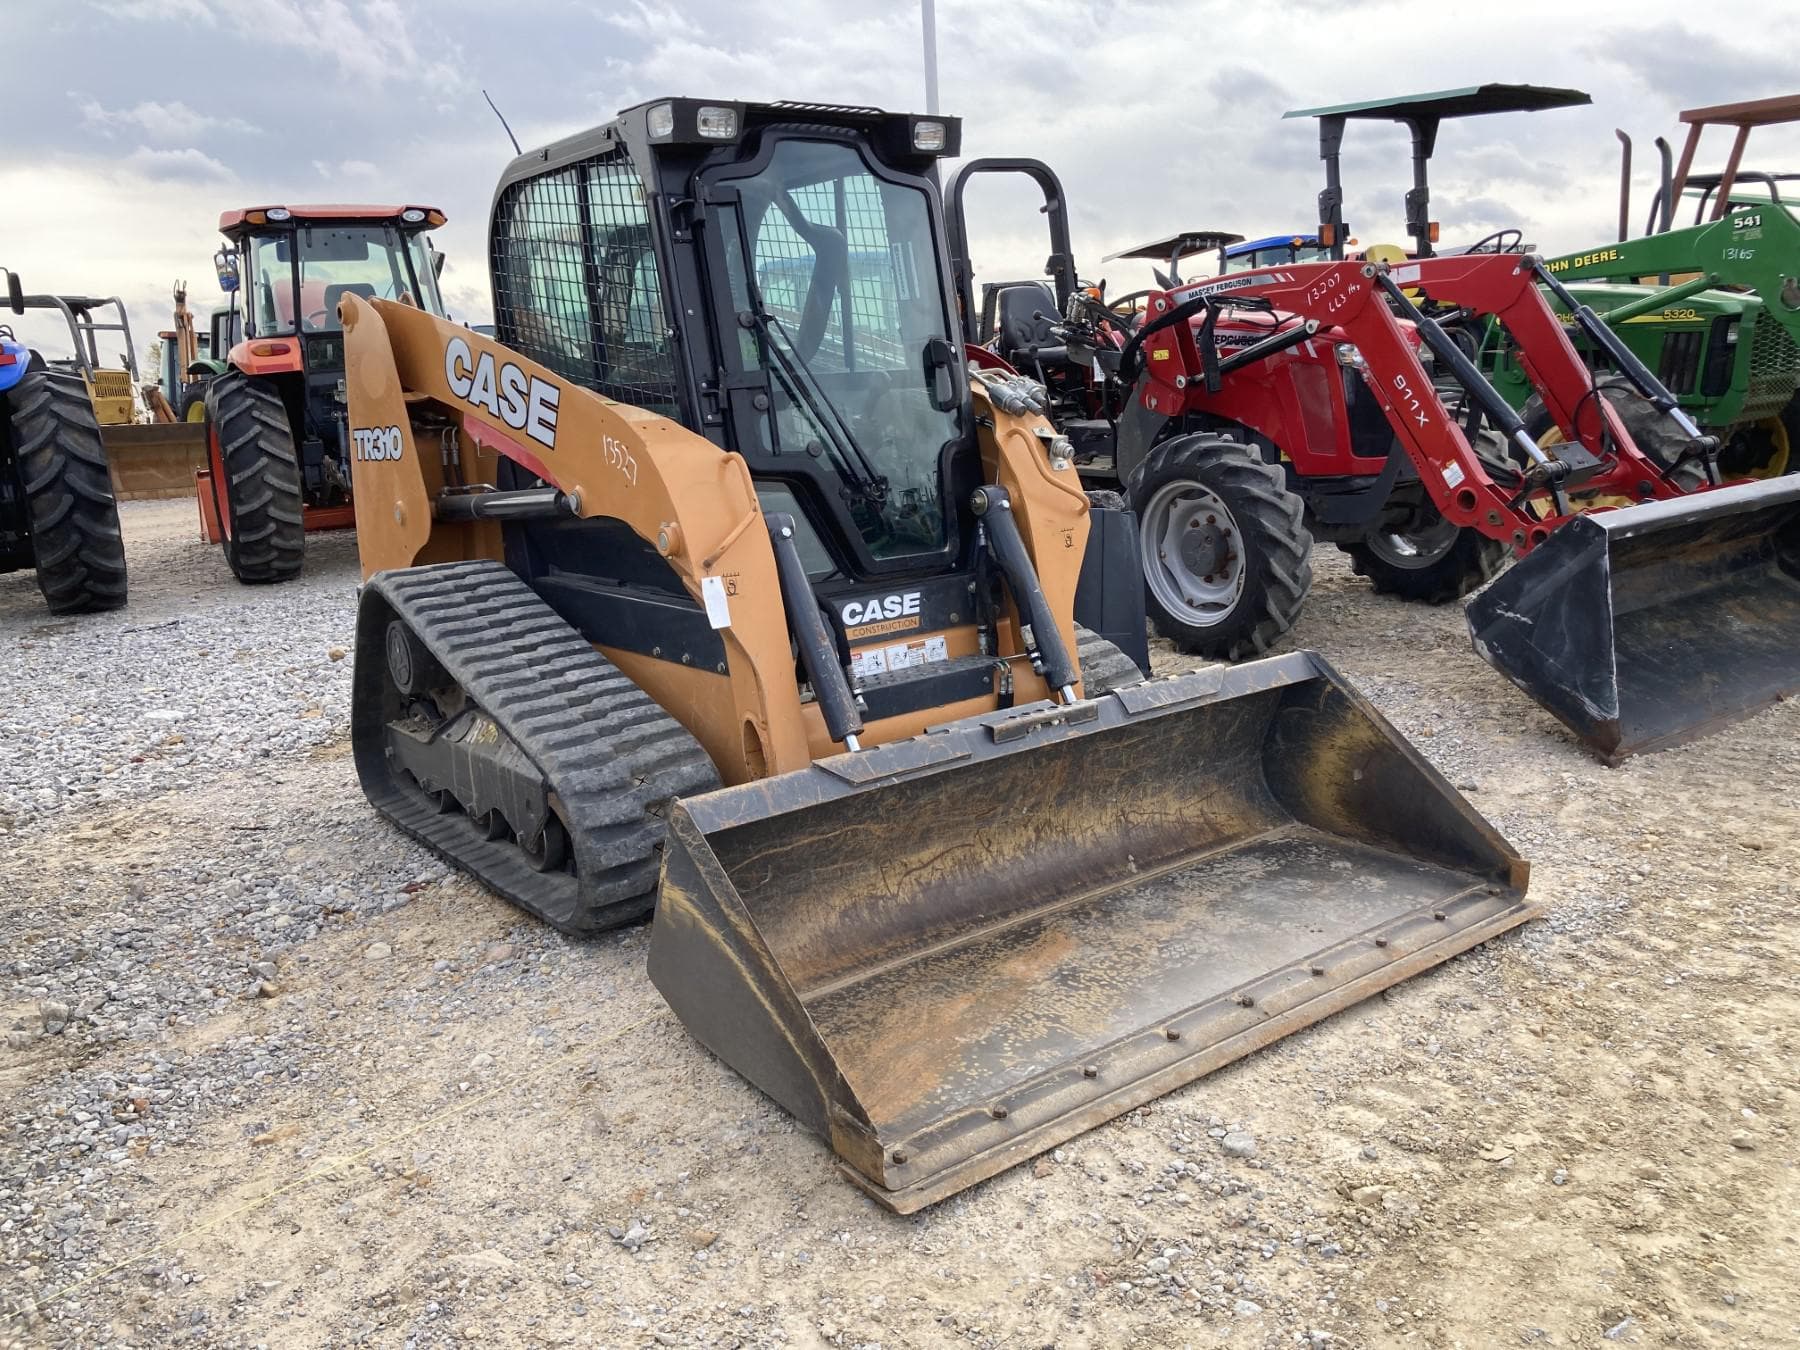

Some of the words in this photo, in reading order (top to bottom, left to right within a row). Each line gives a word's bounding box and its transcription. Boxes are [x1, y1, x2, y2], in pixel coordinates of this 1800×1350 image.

[1734, 215, 1761, 229] 541
[1542, 260, 1569, 273] OHN
[1574, 249, 1618, 268] DEERE
[1216, 278, 1252, 291] FERGUSON
[1307, 272, 1341, 306] 13207
[1663, 308, 1696, 319] 5320
[446, 337, 560, 450] CASE
[1393, 374, 1430, 428] 911X
[353, 425, 403, 461] TR310
[602, 433, 637, 488] 13527
[842, 592, 920, 625] CASE
[853, 617, 917, 636] CONSTRUCTION
